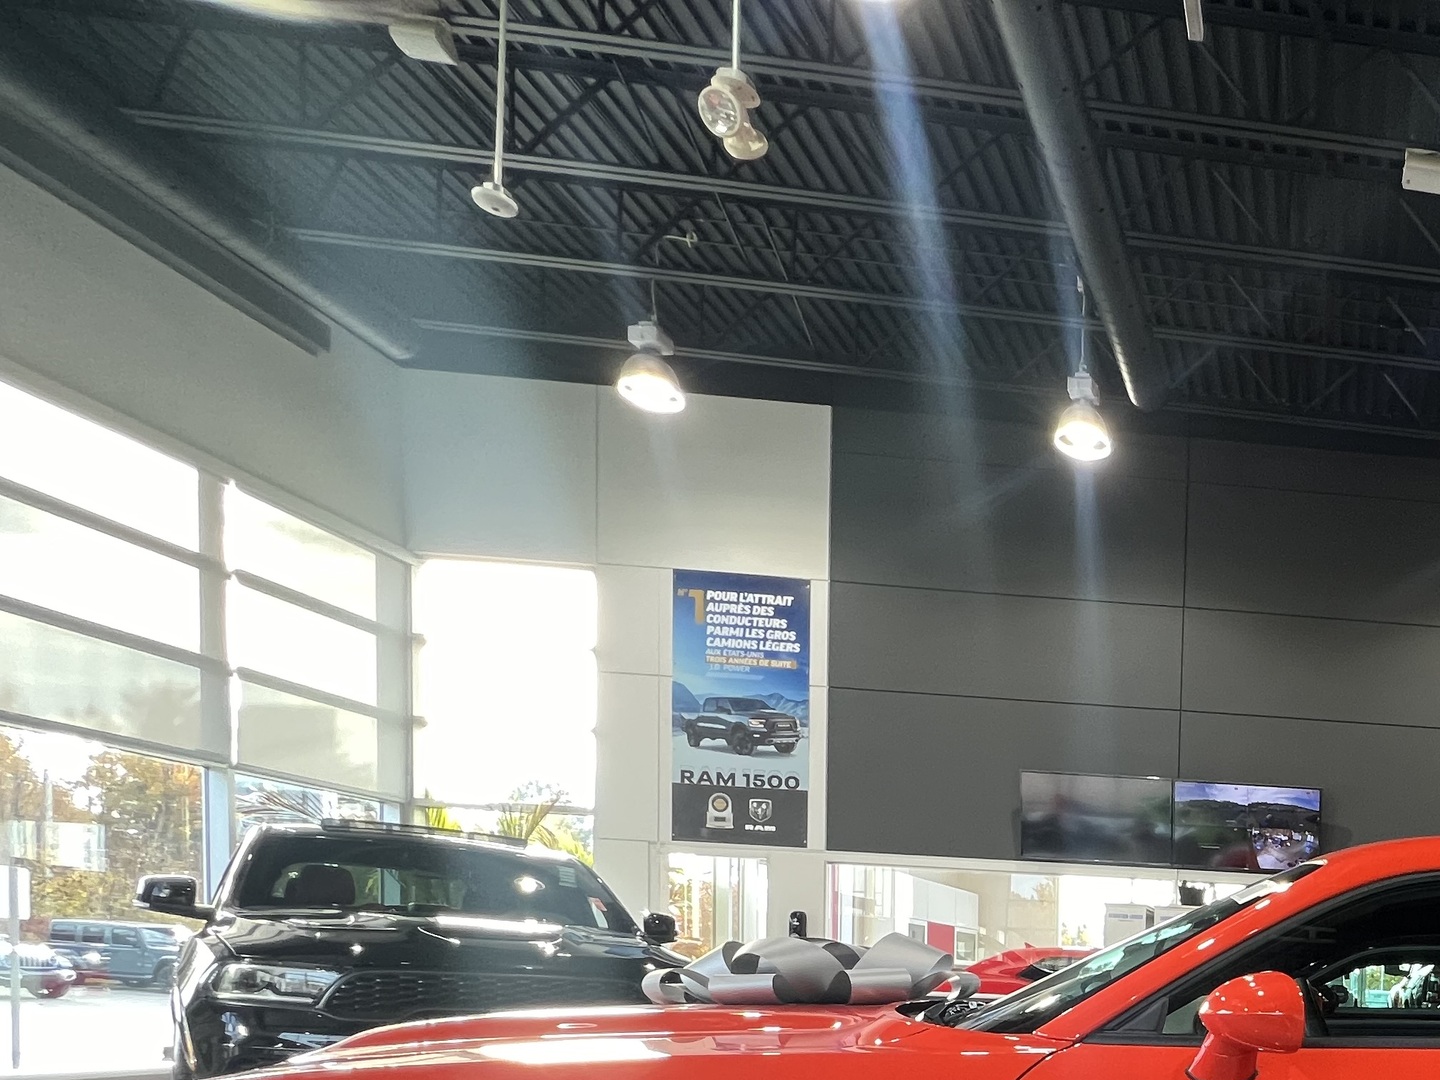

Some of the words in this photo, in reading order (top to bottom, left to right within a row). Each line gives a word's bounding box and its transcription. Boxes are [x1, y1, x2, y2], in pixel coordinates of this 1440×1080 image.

[706, 590, 738, 602] POUR
[740, 592, 795, 606] L'ATTRAIT
[688, 589, 705, 625] 1
[706, 602, 751, 615] AUPRÈS
[752, 606, 775, 616] DES
[706, 614, 788, 629] CONDUCTEURS
[706, 625, 744, 638] PARMI
[745, 627, 765, 639] LES
[766, 630, 797, 641] GROS
[706, 637, 759, 650] CAMIONS
[759, 640, 801, 653] LÉGERS
[727, 657, 758, 666] ANNÉES
[759, 659, 769, 667] DE
[680, 769, 736, 786] RAM
[742, 773, 801, 789] 1500
[744, 824, 777, 832] RAM
